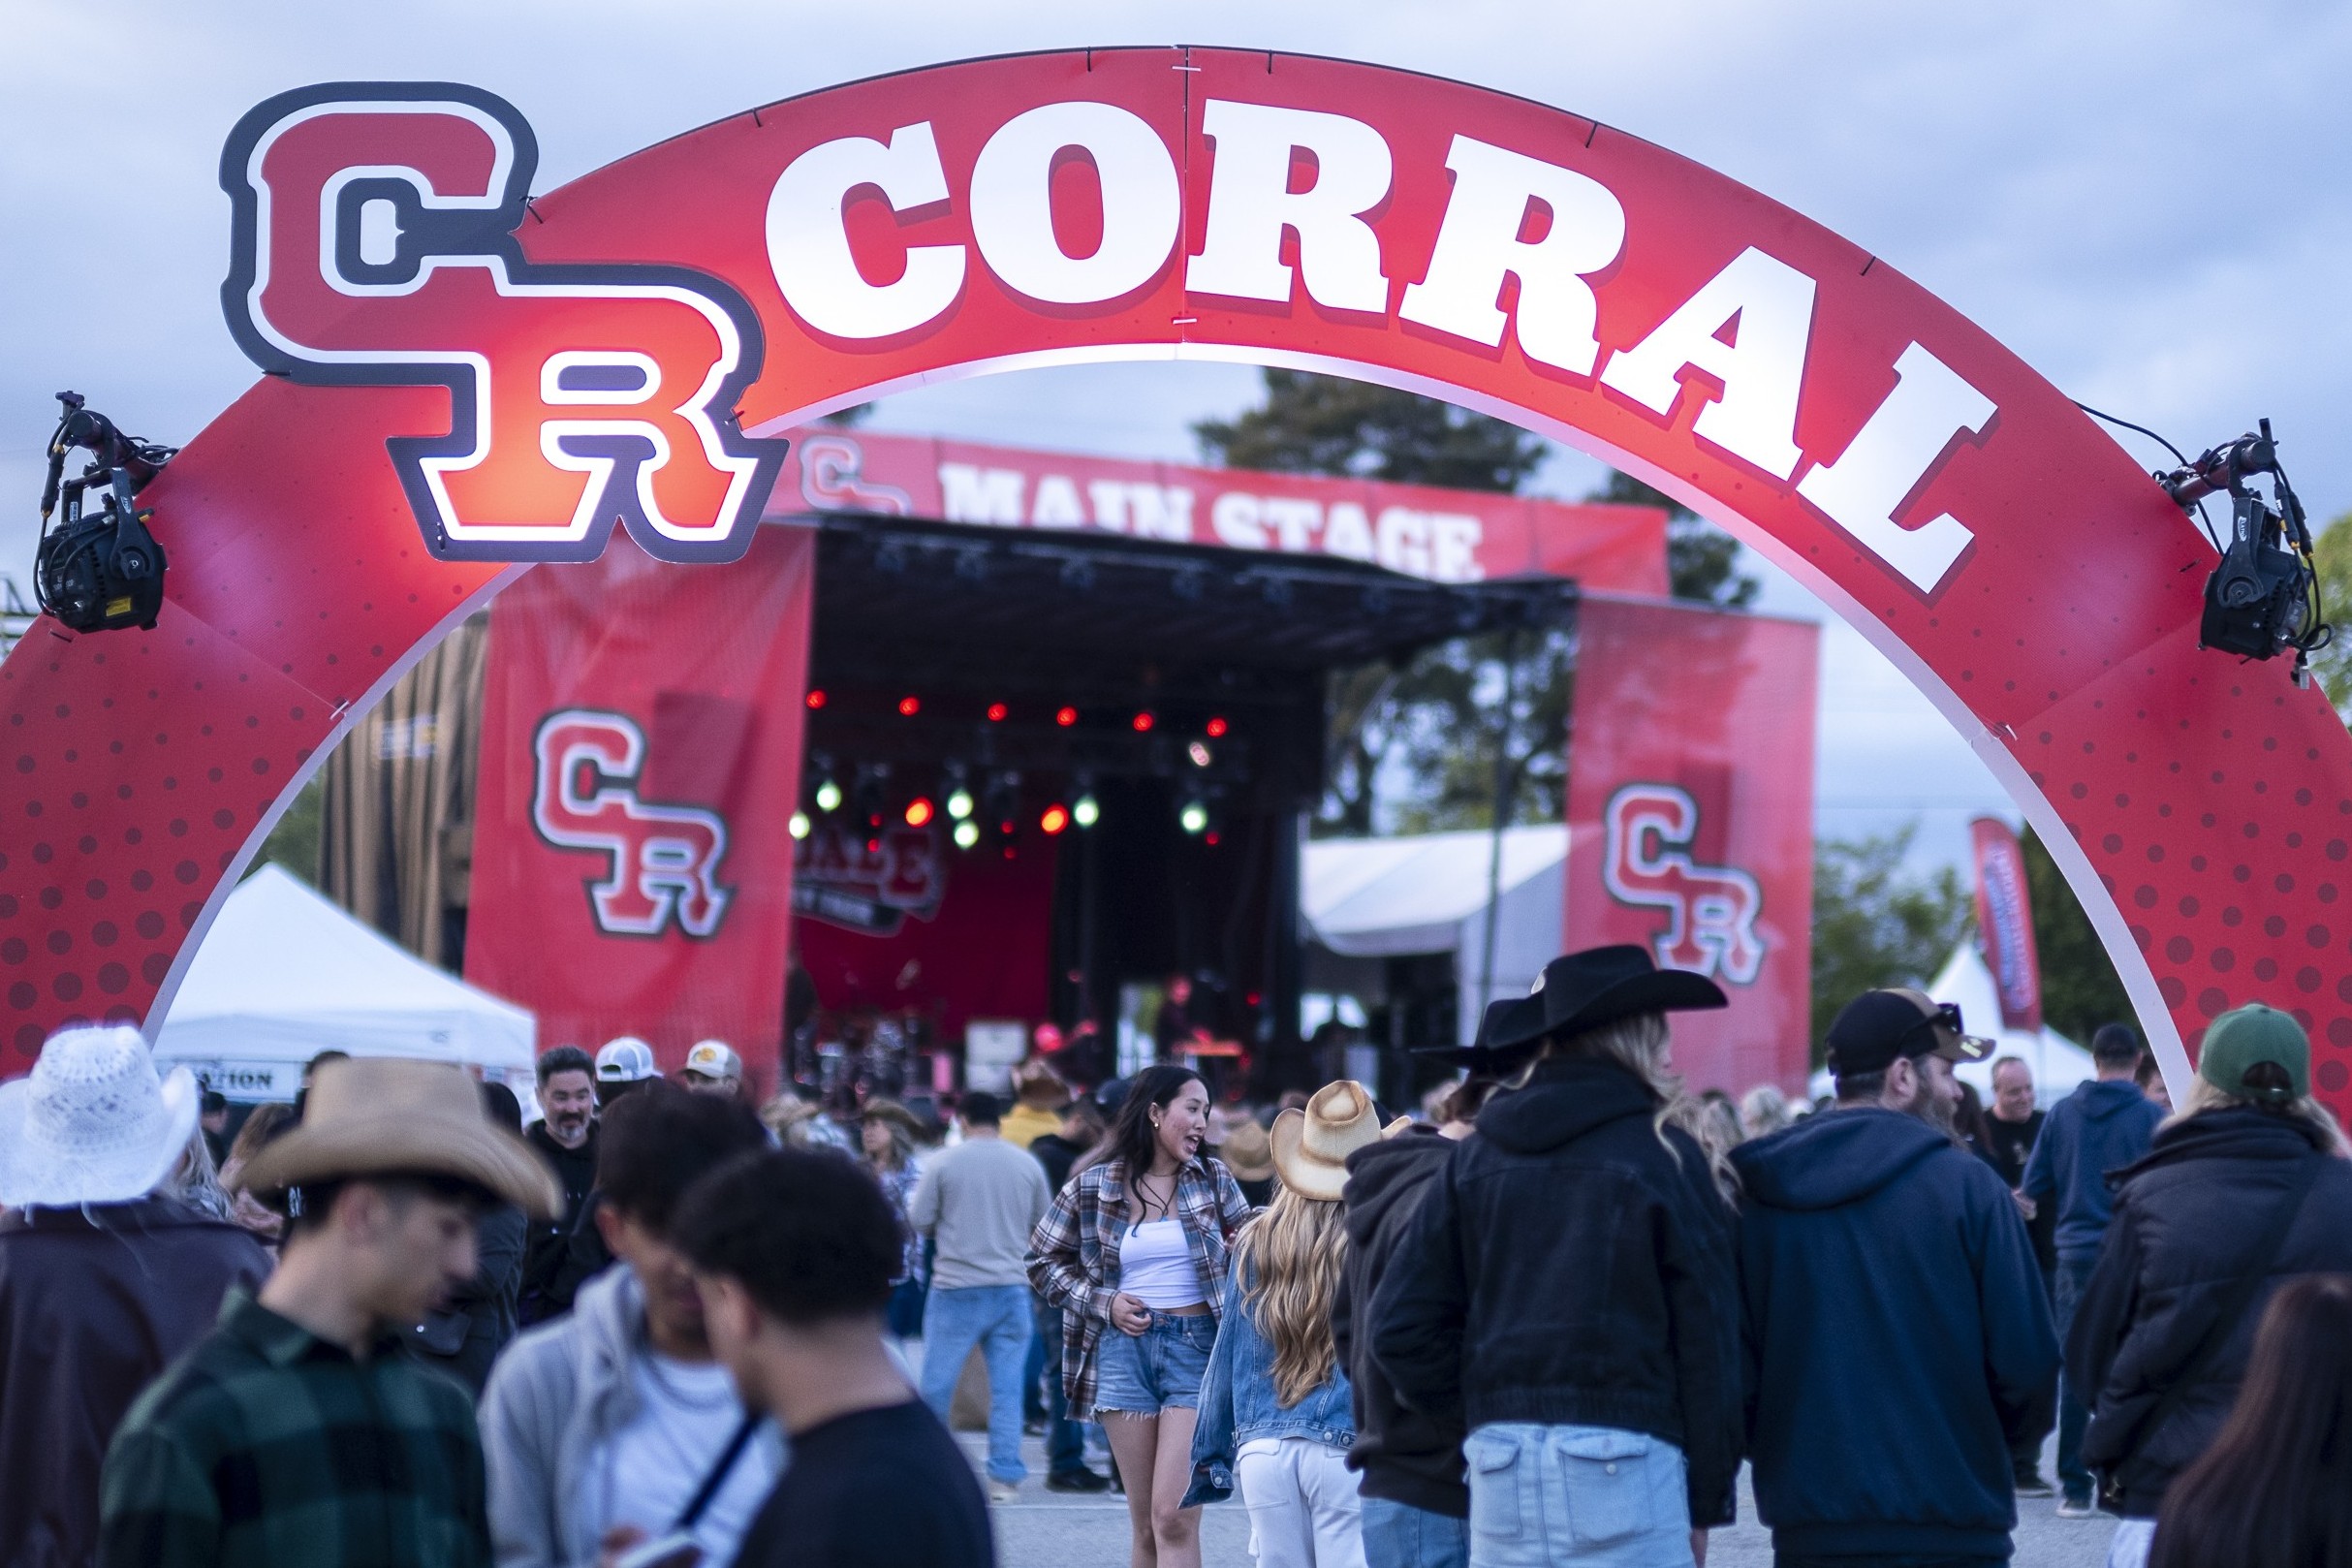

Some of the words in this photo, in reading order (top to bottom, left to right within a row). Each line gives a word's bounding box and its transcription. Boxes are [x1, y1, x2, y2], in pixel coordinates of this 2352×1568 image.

[221, 83, 790, 563] CR
[765, 98, 1999, 594] CORRAL
[937, 462, 1193, 545] MAIN
[1210, 491, 1486, 583] STAGE
[534, 708, 735, 937] CR
[1604, 781, 1768, 985] CR
